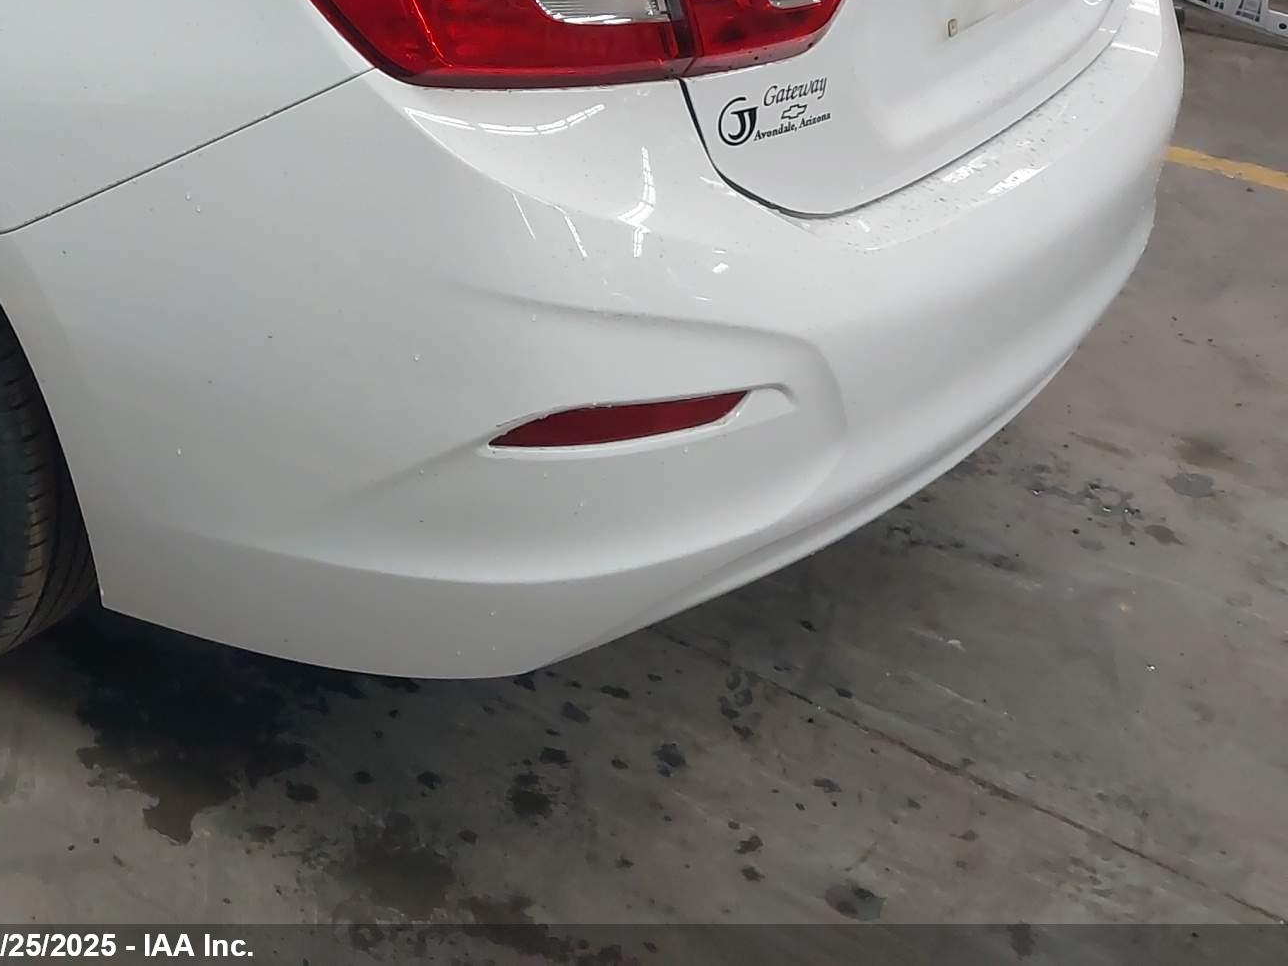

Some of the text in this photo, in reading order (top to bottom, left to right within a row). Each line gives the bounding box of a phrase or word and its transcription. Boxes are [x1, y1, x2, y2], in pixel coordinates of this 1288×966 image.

[763, 77, 827, 106] Gateway
[753, 112, 831, 141] Avondale, Arizona
